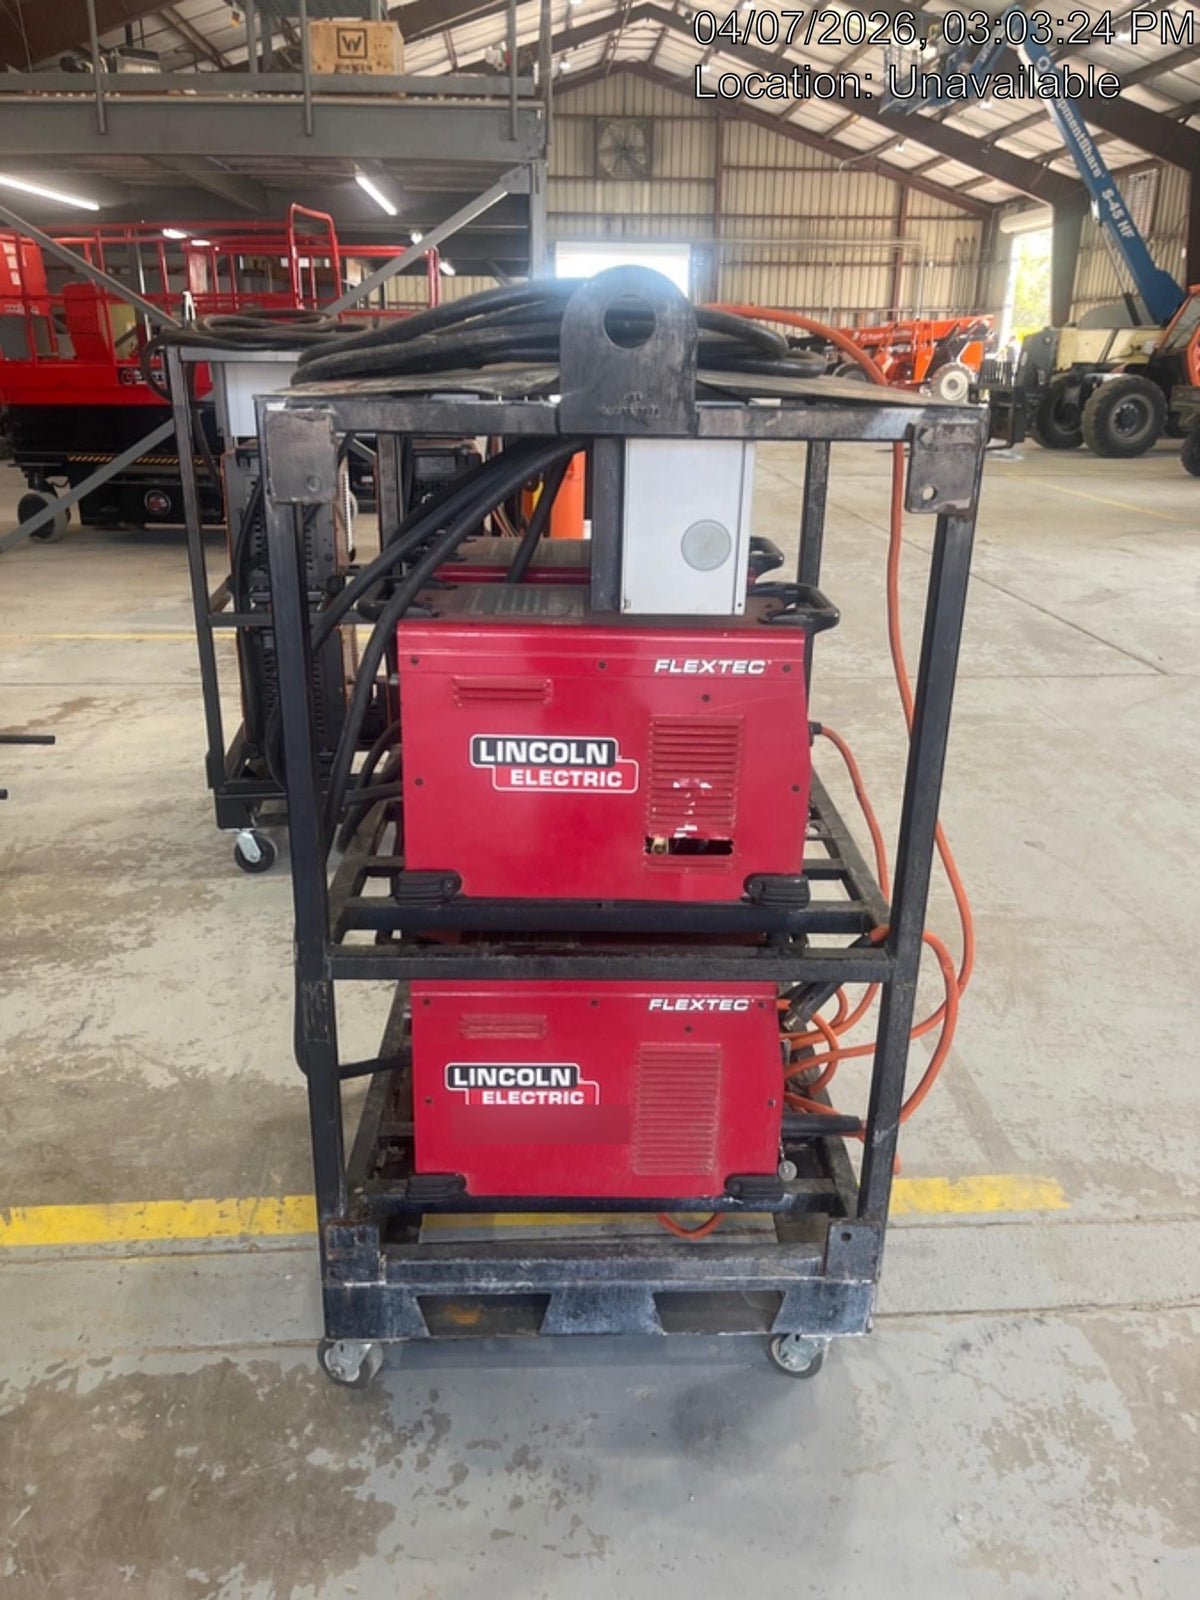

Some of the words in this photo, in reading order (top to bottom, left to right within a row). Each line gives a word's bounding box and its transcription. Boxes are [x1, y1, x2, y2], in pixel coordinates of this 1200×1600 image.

[1117, 219, 1136, 238] HF
[654, 659, 767, 675] FLEXTEC
[479, 740, 608, 765] LINCOLN
[510, 768, 623, 788] ELECTRIC
[648, 998, 749, 1011] FLEXTEC
[453, 1067, 571, 1087] LINCOLN
[482, 1090, 585, 1106] ELECTRIC
